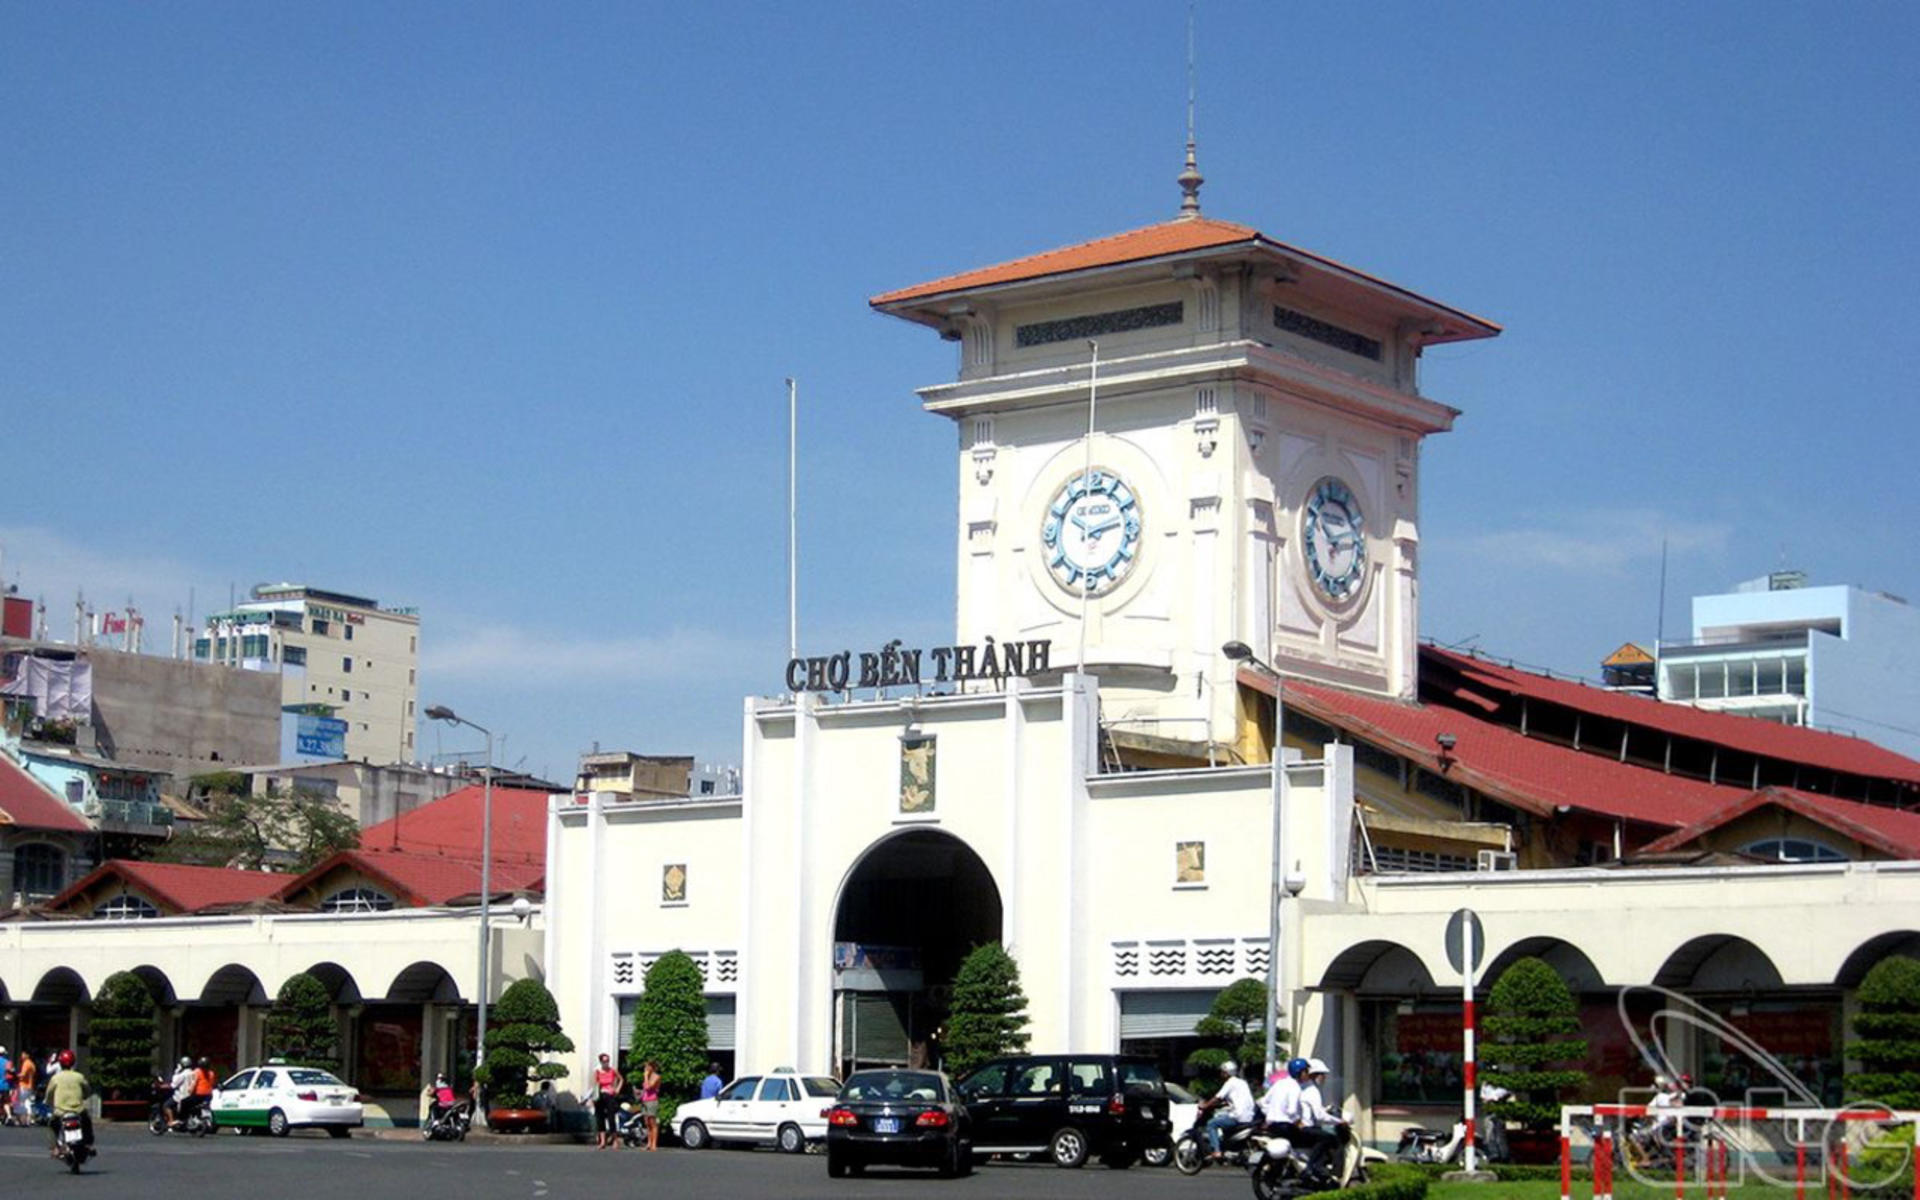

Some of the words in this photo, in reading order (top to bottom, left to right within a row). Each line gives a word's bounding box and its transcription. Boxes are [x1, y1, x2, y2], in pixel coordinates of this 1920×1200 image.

[786, 651, 850, 693] CHỢ
[859, 639, 922, 688] BẾN
[931, 635, 1052, 681] THÀNH
